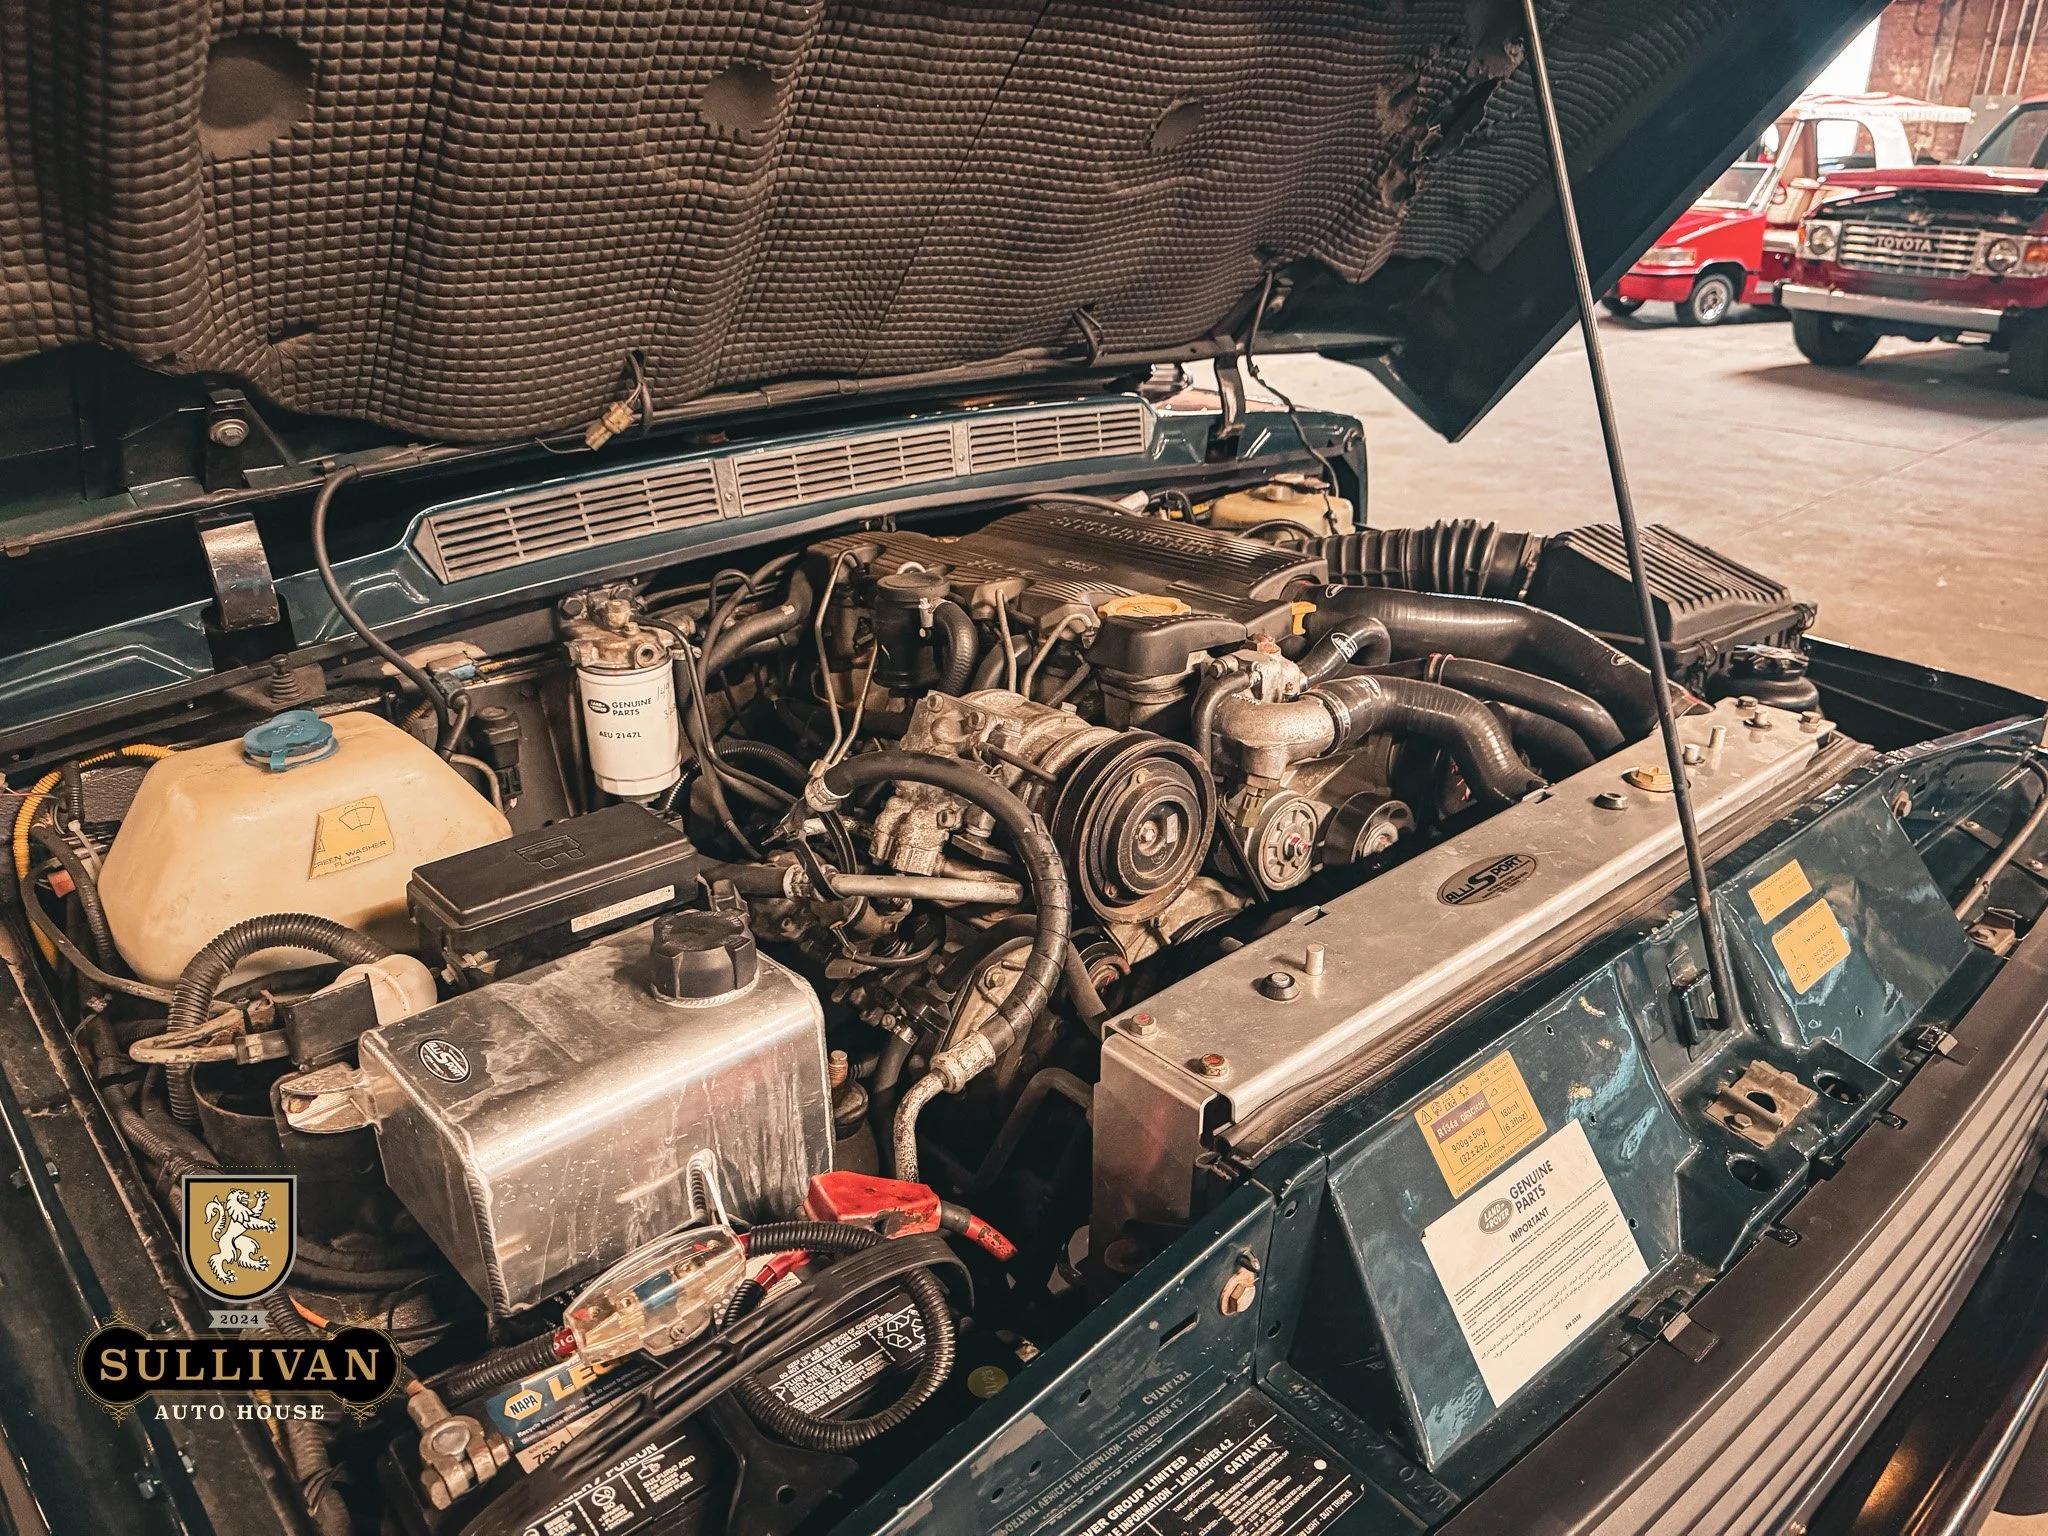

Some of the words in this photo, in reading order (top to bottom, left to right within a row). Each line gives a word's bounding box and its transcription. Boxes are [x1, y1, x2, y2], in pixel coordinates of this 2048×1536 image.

[1876, 236, 1931, 251] TOYOTA
[611, 698, 651, 708] GENUINE
[612, 708, 639, 716] PARTS
[313, 854, 342, 870] CREEN
[345, 840, 387, 856] WASHER
[1500, 1100, 1519, 1118] 180ml
[1436, 1118, 1459, 1138] R134a
[1484, 1143, 1505, 1162] CAUTION
[1508, 1159, 1553, 1199] GENUINE
[1514, 1183, 1546, 1213] PARTS
[1482, 1203, 1502, 1222] LAND
[1487, 1207, 1510, 1229] ROVER
[1508, 1206, 1550, 1242] IMPORTANT
[784, 1372, 806, 1388] FLUSH
[805, 1363, 822, 1376] EYES
[822, 1340, 861, 1366] IMMEDIATELY
[788, 1380, 806, 1393] WITH
[829, 1358, 843, 1370] GET
[793, 1378, 820, 1398] MEDICAL
[820, 1368, 837, 1382] HELP
[837, 1359, 854, 1372] FAST
[509, 1392, 538, 1416] NAPA
[516, 1421, 540, 1438] Recycle
[677, 1454, 695, 1468] ACID
[1223, 1432, 1272, 1474] CATALYST
[1082, 1516, 1109, 1535] OVER
[1106, 1486, 1147, 1521] GROUP
[1143, 1453, 1189, 1492] LIMITED
[1119, 1486, 1173, 1533] INFORMATION
[1175, 1465, 1198, 1486] LAND
[1195, 1446, 1222, 1470] ROVER
[1218, 1437, 1234, 1452] 4.2
[602, 1500, 616, 1512] NO
[1303, 1517, 1320, 1534] LIGHT
[1319, 1504, 1335, 1519] DUTY
[1332, 1489, 1353, 1509] TRUCKS
[547, 1519, 569, 1536] EYES
